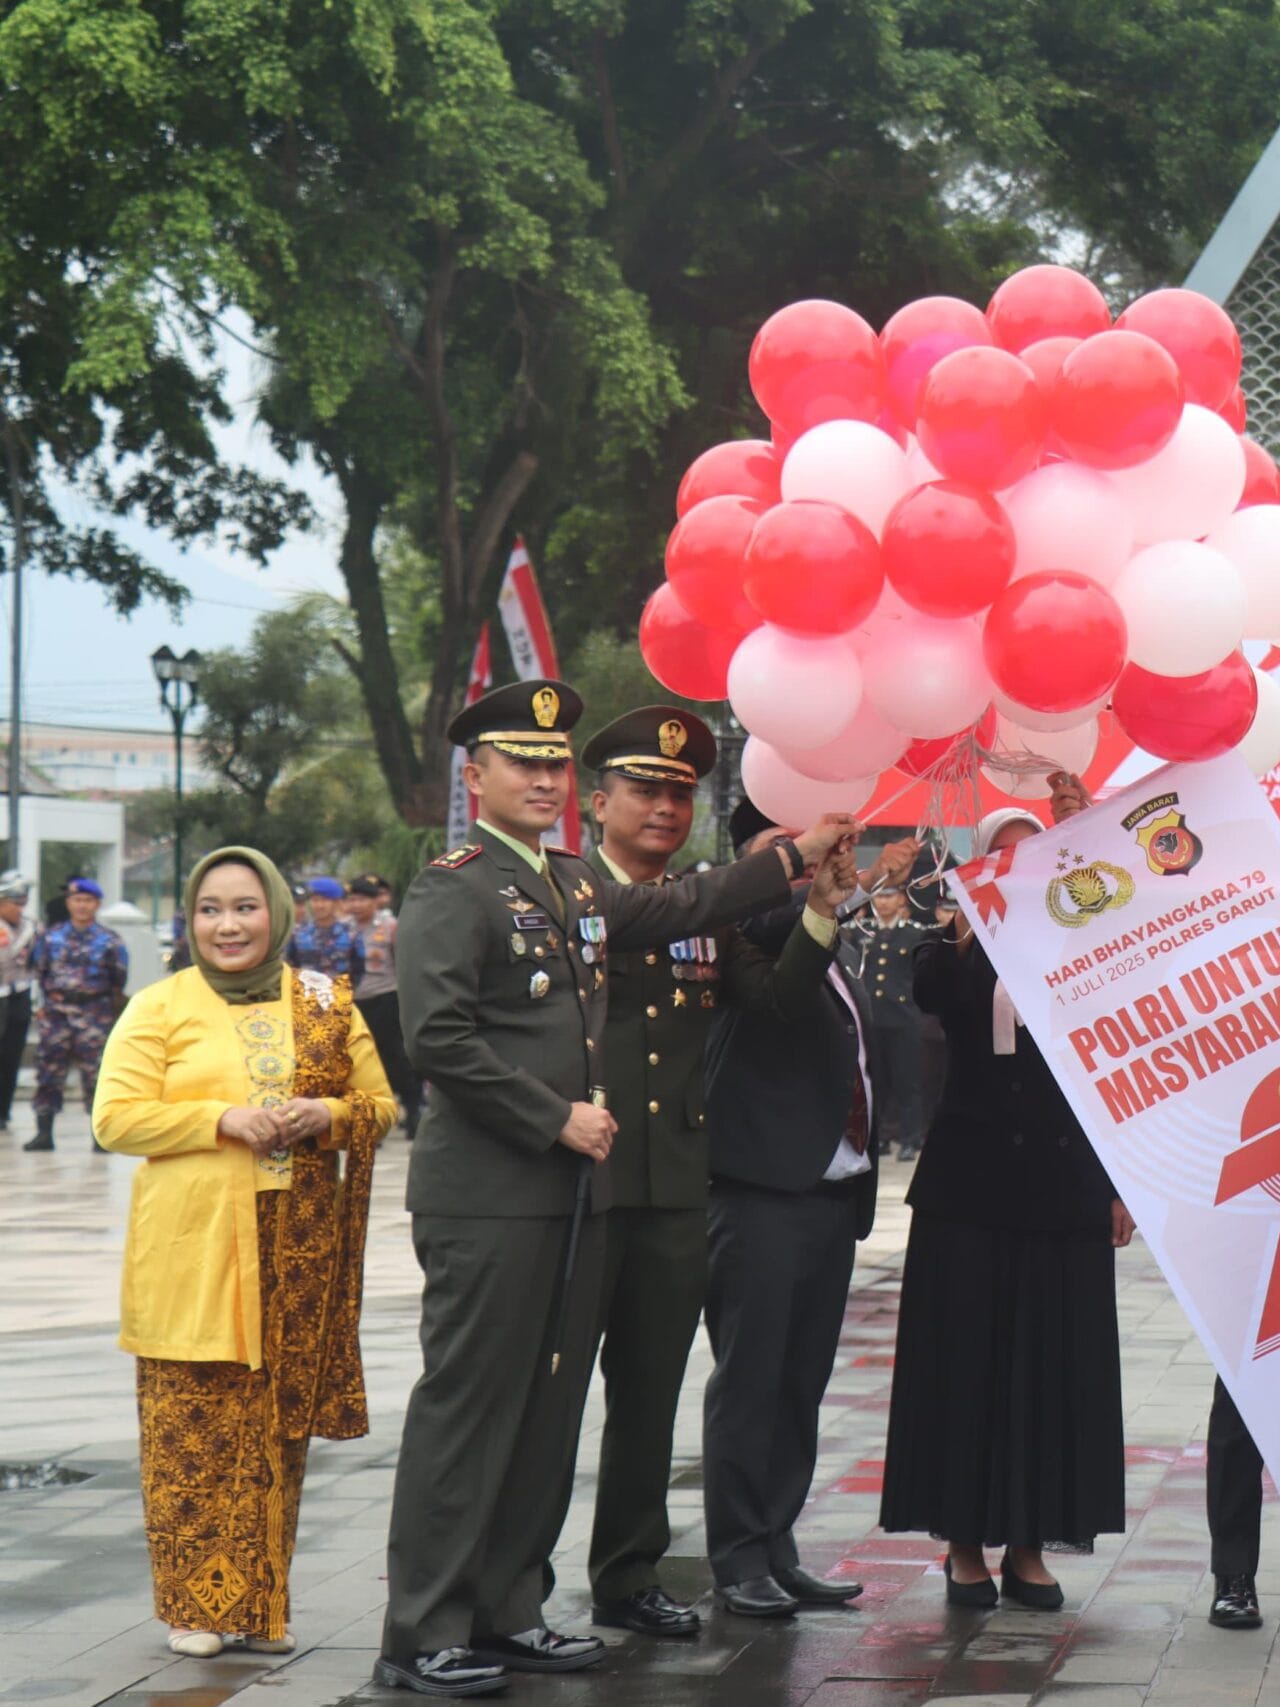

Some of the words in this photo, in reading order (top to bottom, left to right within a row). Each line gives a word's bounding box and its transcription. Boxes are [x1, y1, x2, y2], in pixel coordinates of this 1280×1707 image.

[1126, 808, 1147, 827] JAWA
[1146, 795, 1175, 812] BARAT
[1045, 955, 1094, 988] HARI
[1094, 883, 1243, 964] BHAYANGKARA
[1241, 870, 1267, 889] 79
[1056, 994, 1067, 1007] 1
[1069, 974, 1106, 1002] JULI
[1108, 953, 1147, 982] 2025
[1147, 917, 1215, 960] POLRES
[1215, 886, 1278, 925] GARUT
[1069, 985, 1188, 1073] POLRI
